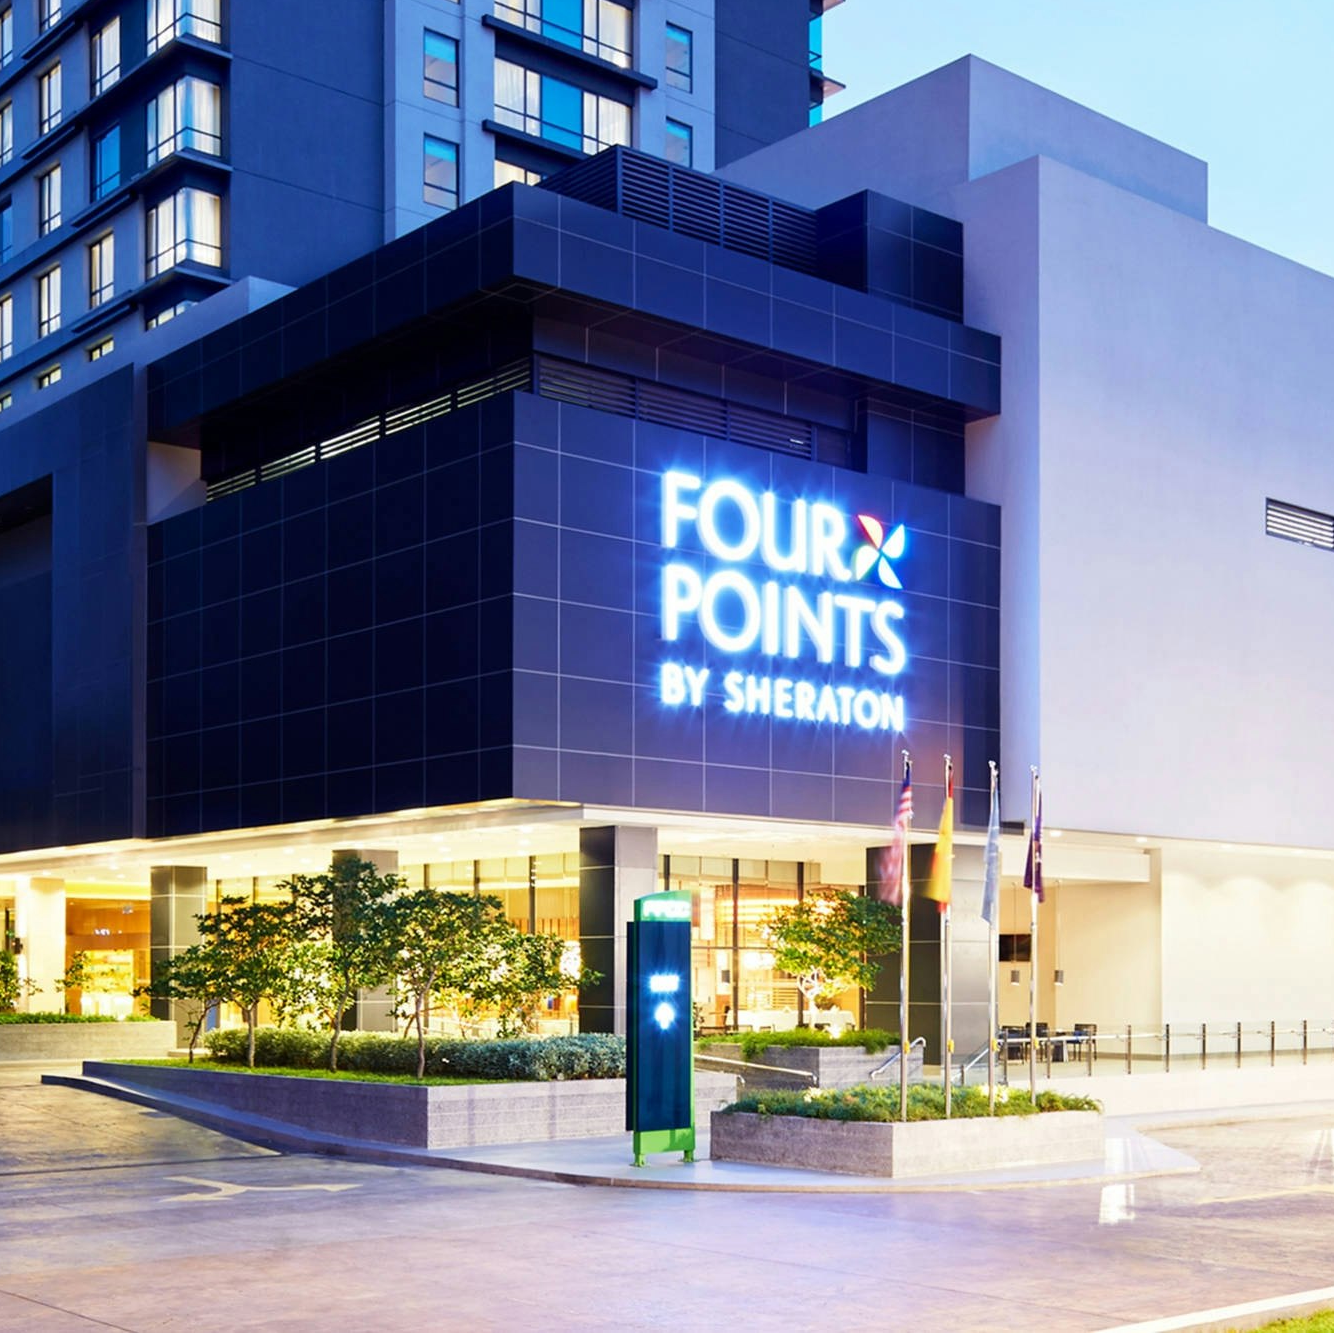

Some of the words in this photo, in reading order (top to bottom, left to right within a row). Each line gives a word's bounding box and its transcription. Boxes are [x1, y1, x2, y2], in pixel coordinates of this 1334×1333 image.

[662, 472, 851, 580] FOUR
[663, 566, 905, 675] POINTS
[662, 664, 708, 706] BY
[724, 674, 904, 731] SHERATON
